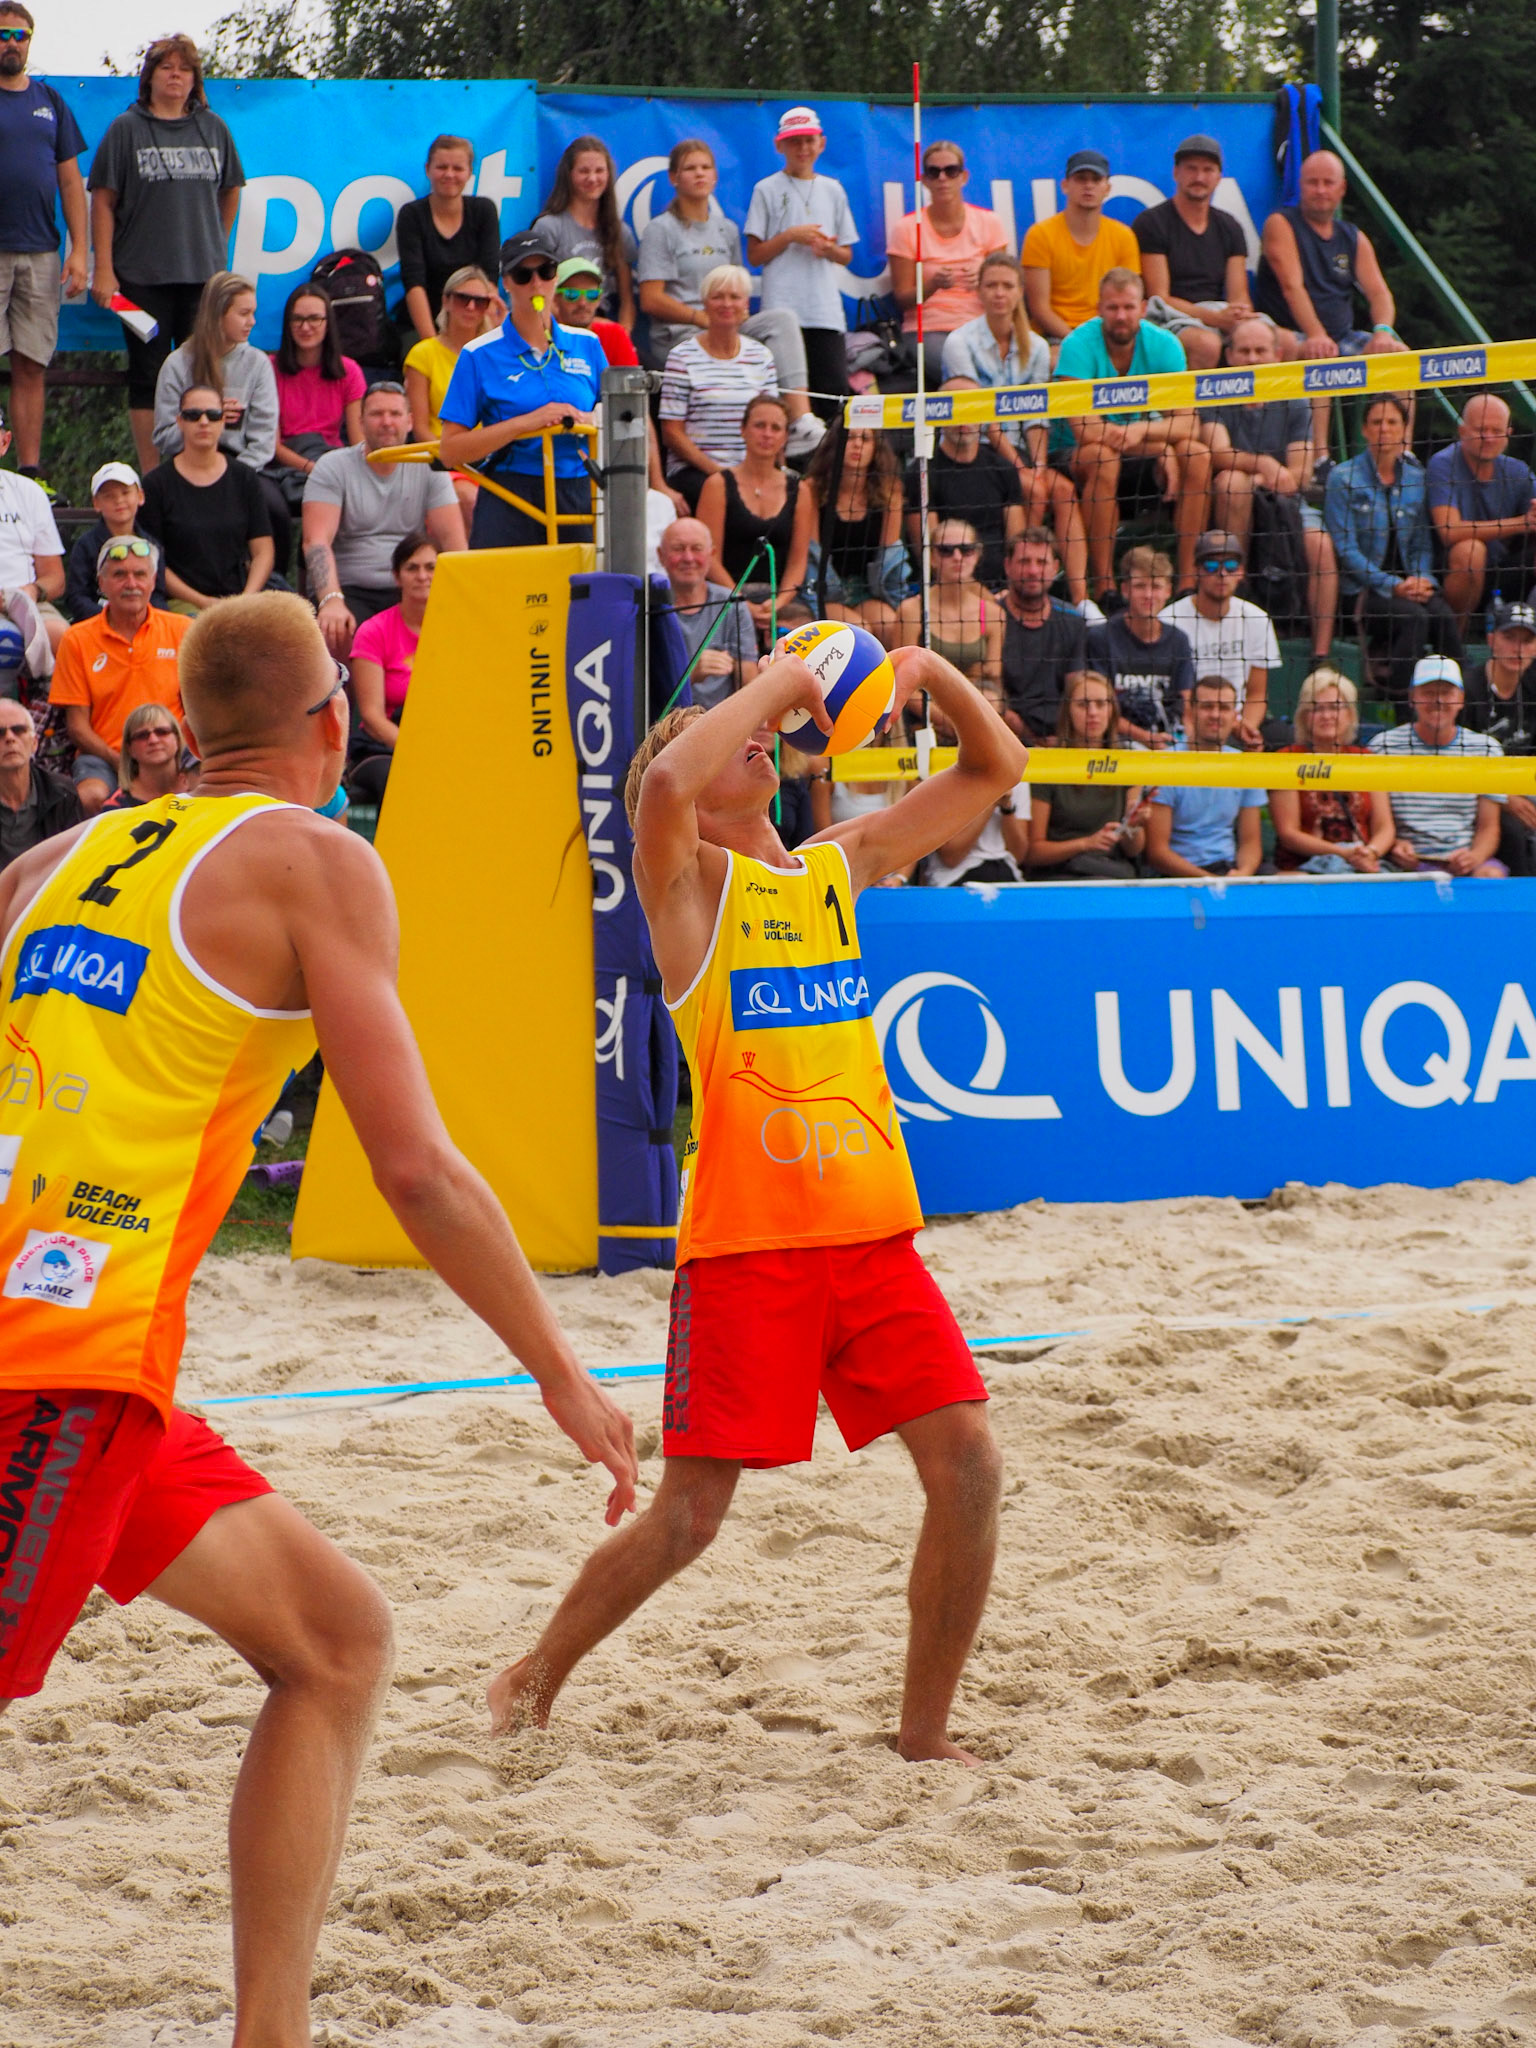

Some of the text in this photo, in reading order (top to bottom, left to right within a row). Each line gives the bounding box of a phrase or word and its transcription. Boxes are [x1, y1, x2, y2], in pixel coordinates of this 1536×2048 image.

[1325, 367, 1363, 386] UNIQA
[1441, 357, 1482, 377] UNIQA
[1111, 386, 1145, 405] UNIQA
[1216, 378, 1250, 396] UNIQA
[923, 400, 950, 418] NIQA
[1012, 394, 1046, 411] UNIQA
[814, 646, 845, 681] Beach
[530, 647, 553, 757] JINLING
[573, 638, 626, 911] UNIQA
[897, 754, 919, 775] gal
[1086, 756, 1118, 777] gala
[1297, 758, 1333, 783] gala
[78, 818, 178, 907] 2
[763, 919, 791, 931] BEACH
[824, 884, 850, 946] 1
[1094, 979, 1536, 1117] UNIQA
[72, 1181, 141, 1212] BEACH
[15, 1235, 77, 1270] AGENTURA
[22, 1282, 74, 1299] KAMIZ
[1, 1405, 96, 1605] UNDER
